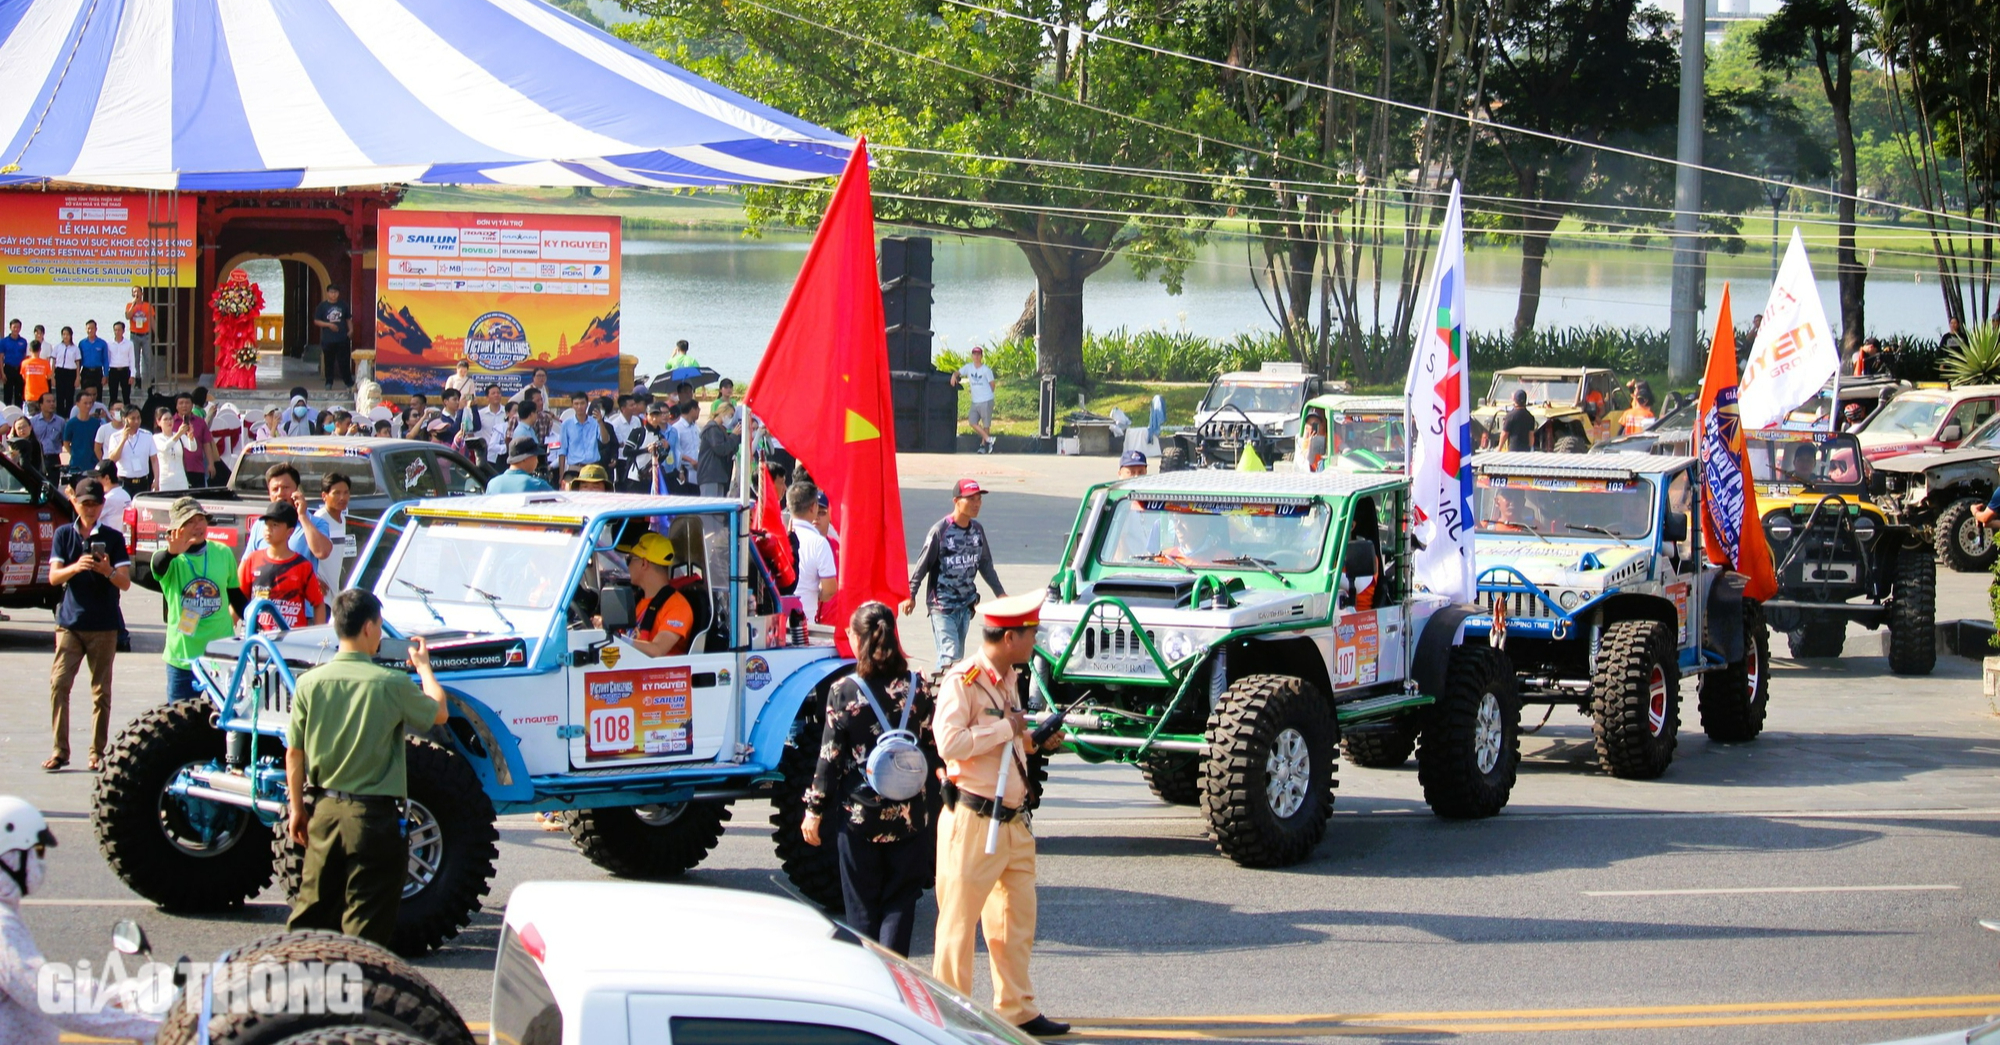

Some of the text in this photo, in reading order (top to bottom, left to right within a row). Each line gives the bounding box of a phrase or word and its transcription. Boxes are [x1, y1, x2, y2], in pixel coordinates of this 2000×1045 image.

[74, 225, 99, 235] KHAI
[102, 225, 127, 238] MẠC
[0, 235, 17, 246] GÀY
[20, 237, 35, 248] HỘI
[54, 238, 79, 247] THAO
[81, 237, 89, 247] VÌ
[407, 235, 457, 244] SAILUN
[23, 248, 56, 257] SPORTS
[8, 266, 46, 274] VICTORY
[48, 266, 100, 275] CHALLENGE
[102, 267, 132, 276] SAILUN
[464, 338, 530, 355] VICTORY CHALLENGE
[1814, 433, 1827, 442] 102
[345, 447, 358, 457] 331
[1490, 477, 1506, 487] 103
[1608, 481, 1624, 492] 103
[1146, 501, 1163, 509] 107
[1277, 505, 1294, 514] 107
[40, 524, 53, 538] 309
[207, 532, 228, 540] Madin
[947, 555, 979, 565] KELME
[470, 656, 501, 664] CUONG
[1339, 652, 1354, 676] 107
[653, 696, 686, 704] SAILUN
[593, 715, 630, 743] 108
